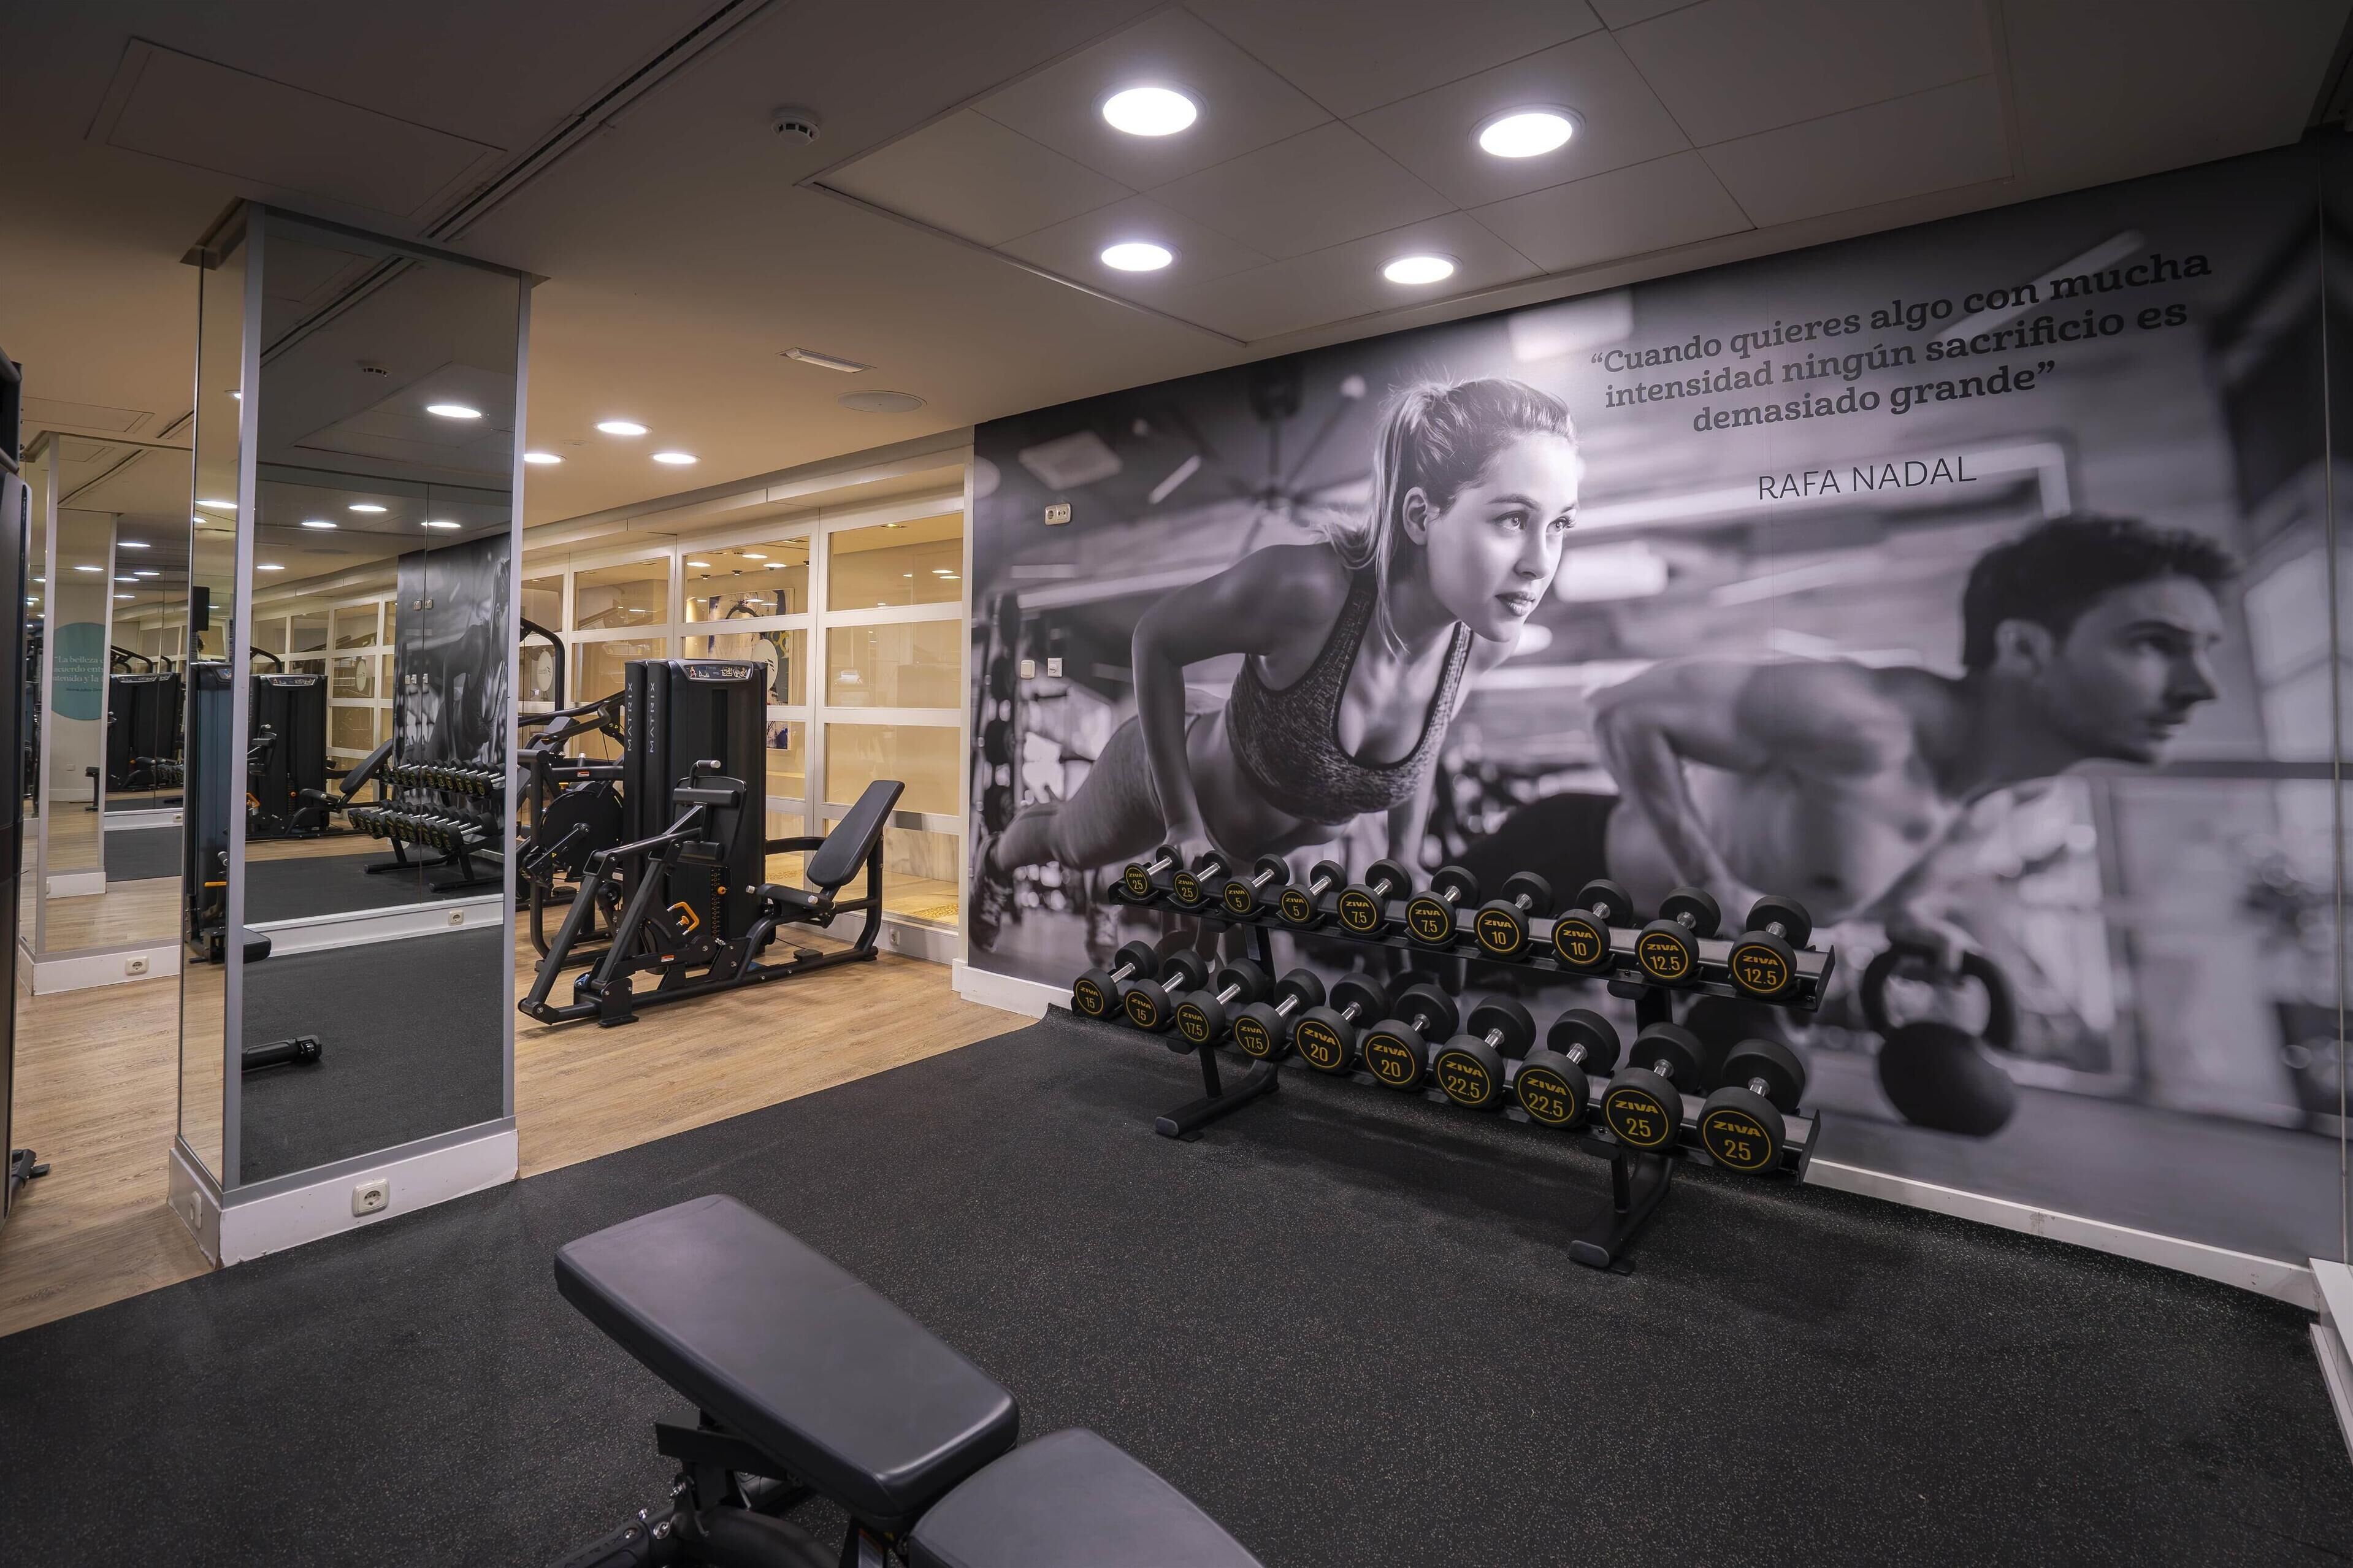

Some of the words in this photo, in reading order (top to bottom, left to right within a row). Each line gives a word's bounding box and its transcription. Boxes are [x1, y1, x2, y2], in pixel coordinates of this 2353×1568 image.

[1590, 334, 1722, 375] “Cuando
[1729, 310, 1862, 359] quieres
[1870, 296, 1954, 339] algo
[1962, 283, 2040, 315] con
[2049, 252, 2212, 302] mucha
[1605, 361, 1773, 408] intensidad
[1781, 342, 1915, 386] ningún
[1925, 310, 2125, 359] sacrificio
[2137, 302, 2188, 331] es
[1693, 386, 1880, 432] demasiado
[1889, 359, 2056, 416] grande”
[1759, 469, 1840, 501] RAFA
[1853, 456, 1977, 492] NADAL
[1236, 898, 1242, 908] 5
[1293, 906, 1300, 917] 5
[1351, 911, 1368, 924] 7.5
[1421, 920, 1438, 933] 7.5
[1484, 919, 1512, 928] ZIVA
[1491, 931, 1507, 946] 10
[1563, 930, 1593, 939] ZIVA
[1571, 941, 1587, 957] 10
[1647, 943, 1680, 952] ZIVA
[1650, 955, 1680, 971] 12.5
[1743, 955, 1778, 966] ZIVA
[1744, 968, 1777, 986] 12.5
[1080, 986, 1099, 996] ZIVA
[1085, 996, 1096, 1009] 15
[1131, 997, 1152, 1009] ZIVA
[1136, 1008, 1147, 1021] 15
[1182, 1011, 1203, 1022] ZIVA
[1185, 1022, 1203, 1037] 17.5
[1240, 1025, 1263, 1034] ZIVA
[1304, 1027, 1336, 1046] ZIVA
[1244, 1036, 1263, 1051] 17.5
[1373, 1043, 1409, 1058] ZIVA
[1310, 1044, 1329, 1062] 20
[1381, 1059, 1401, 1078] 20
[1445, 1060, 1483, 1078] ZIVA
[1447, 1075, 1480, 1099] 22.5
[1526, 1076, 1567, 1097] ZIVA
[1529, 1092, 1564, 1118] 22.5
[1615, 1100, 1659, 1115] ZIVA
[1626, 1117, 1652, 1138] 25
[1713, 1120, 1762, 1138] ZIVA
[1724, 1139, 1752, 1161] 25
